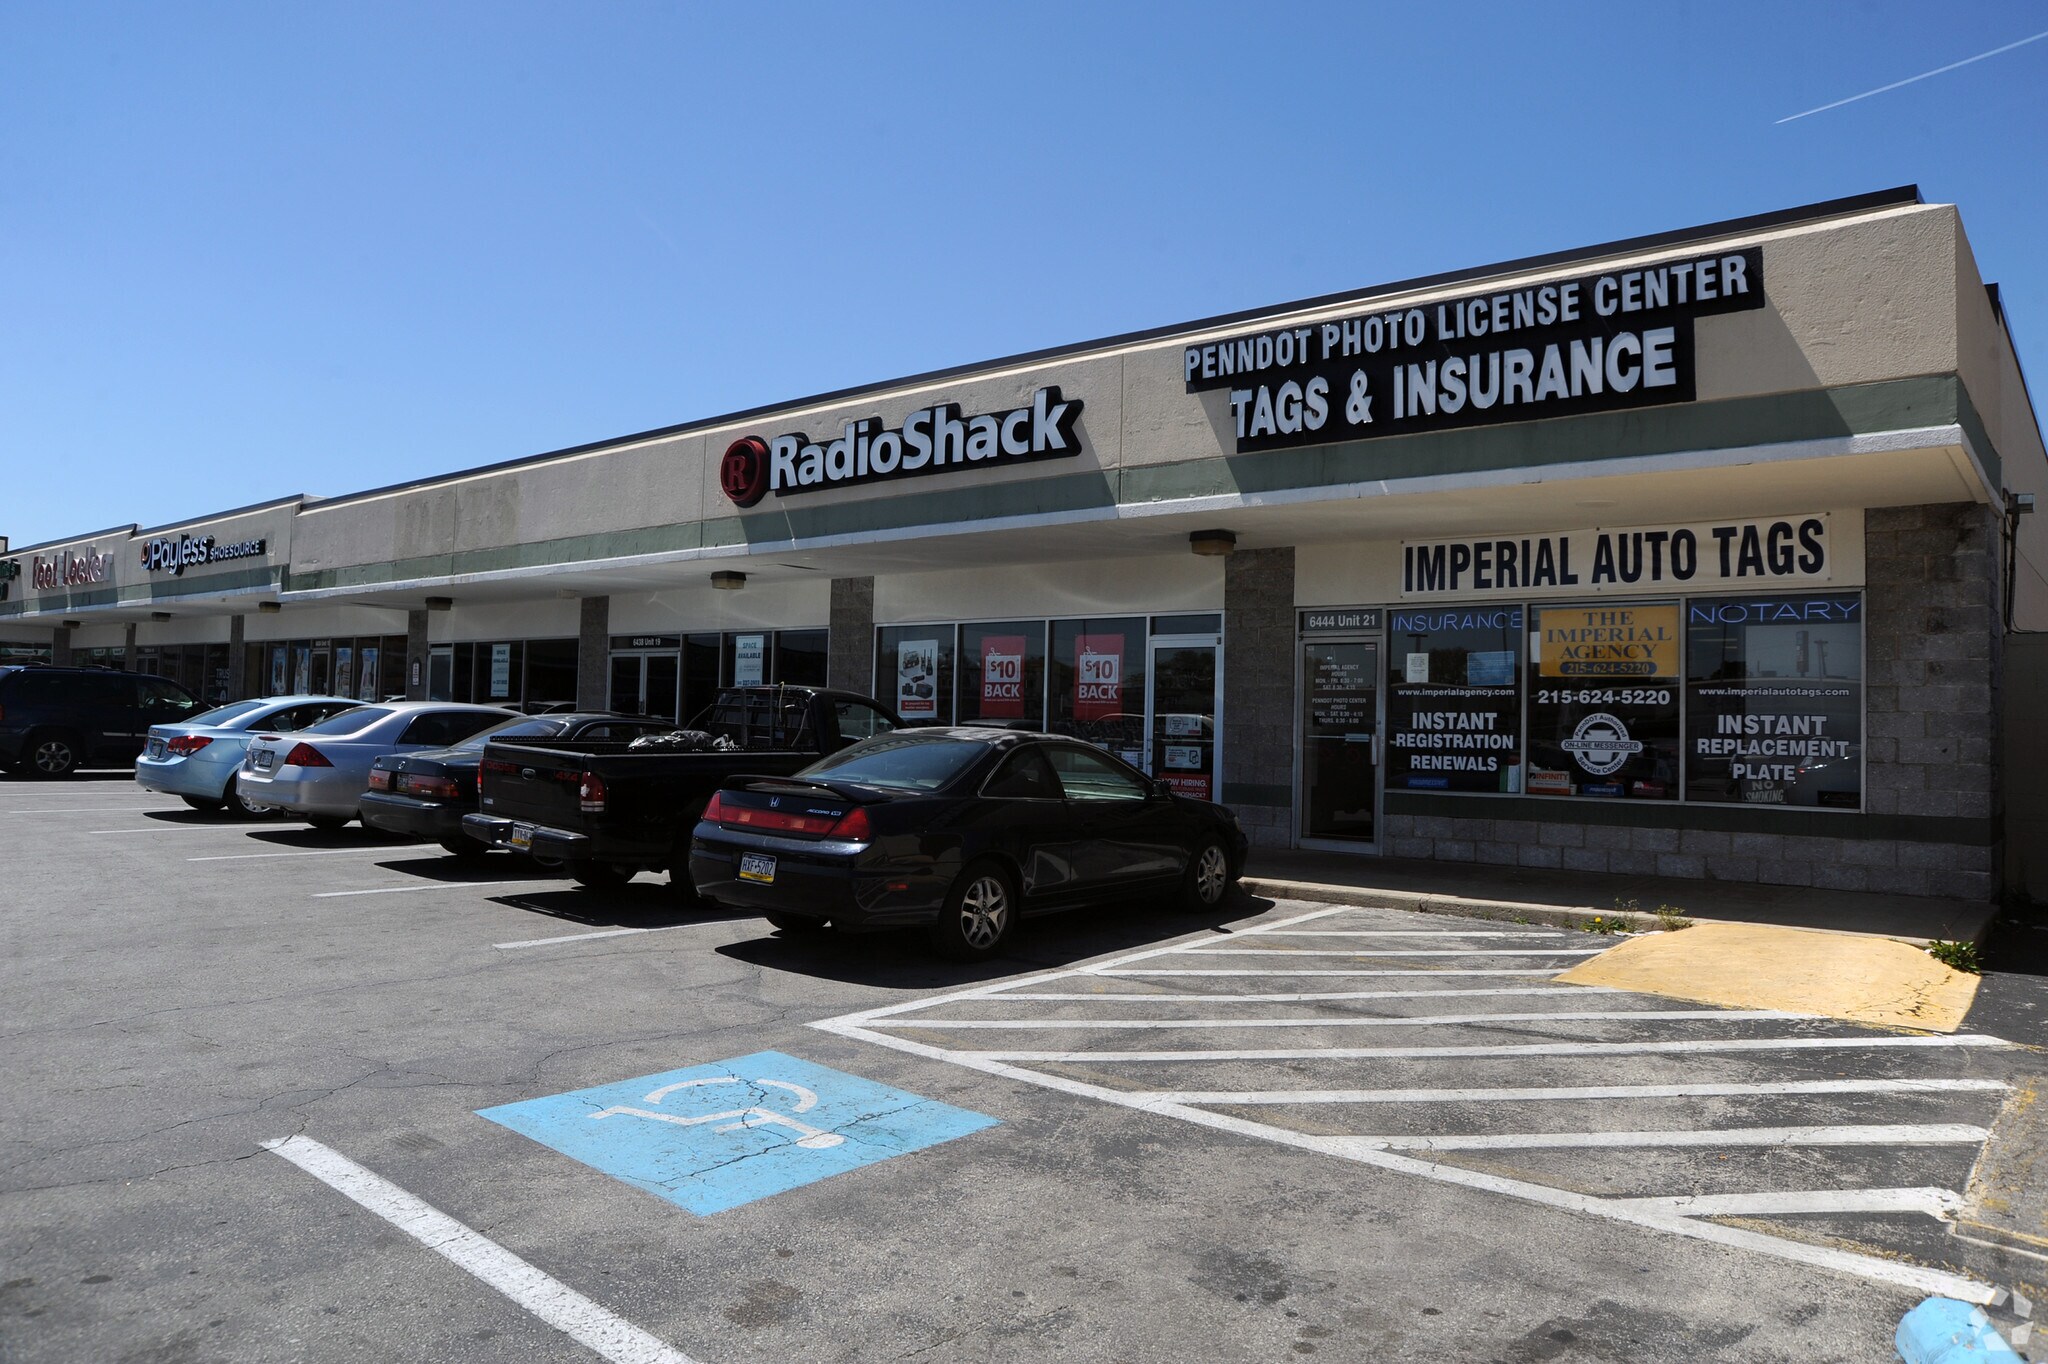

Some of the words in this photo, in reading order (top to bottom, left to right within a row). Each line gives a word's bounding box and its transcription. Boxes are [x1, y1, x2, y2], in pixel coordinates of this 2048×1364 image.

[1185, 329, 1311, 381] PENNDOT
[1322, 309, 1424, 359] PHOTO
[1438, 282, 1579, 339] LICENSE
[1595, 254, 1749, 316] CENTER
[1230, 376, 1329, 438] TAGS
[1345, 368, 1373, 424] &
[1393, 326, 1676, 419] INSURANCE
[770, 388, 1068, 490] RadioShack
[152, 534, 208, 575] Payless
[210, 540, 260, 560] SHOESOURCE
[1405, 536, 1579, 592] IMPERIAL
[1591, 529, 1697, 584] AUTO
[1712, 519, 1825, 577] TAGS
[1309, 616, 1335, 628] 6444
[1338, 615, 1360, 627] Unit
[1363, 614, 1376, 626] 21
[1393, 611, 1523, 631] INSURANCE
[1583, 611, 1634, 626] THE
[1691, 602, 1859, 624] NOTARY
[1547, 626, 1672, 643] IMPERIAL
[1560, 643, 1658, 659] AGENCY
[990, 661, 1015, 679] $10
[1085, 661, 1113, 679] $10
[1567, 663, 1649, 673] 215-624-5220
[984, 684, 1020, 698] BACK
[1079, 685, 1118, 699] BACK
[1398, 688, 1515, 698] www.imperialagency.com
[1538, 690, 1670, 705] 215-624-5220
[1699, 687, 1850, 698] www.imperialautotags.com
[1412, 712, 1497, 730] INSTANT
[1575, 715, 1598, 737] PennDOT
[1599, 715, 1627, 738] Authorized
[1718, 715, 1827, 735] INSTANT
[1396, 733, 1514, 749] REGISTRATION
[1564, 741, 1591, 749] ON-LINE
[1594, 742, 1639, 750] MESSENGER
[1697, 738, 1850, 757] REPLACEMENT
[1410, 755, 1498, 771] RENEWALS
[1577, 756, 1601, 773] Service
[1602, 758, 1623, 774] Center
[1733, 763, 1796, 780] PLATE
[1752, 781, 1774, 791] NO
[1745, 789, 1784, 803] SMOKING
